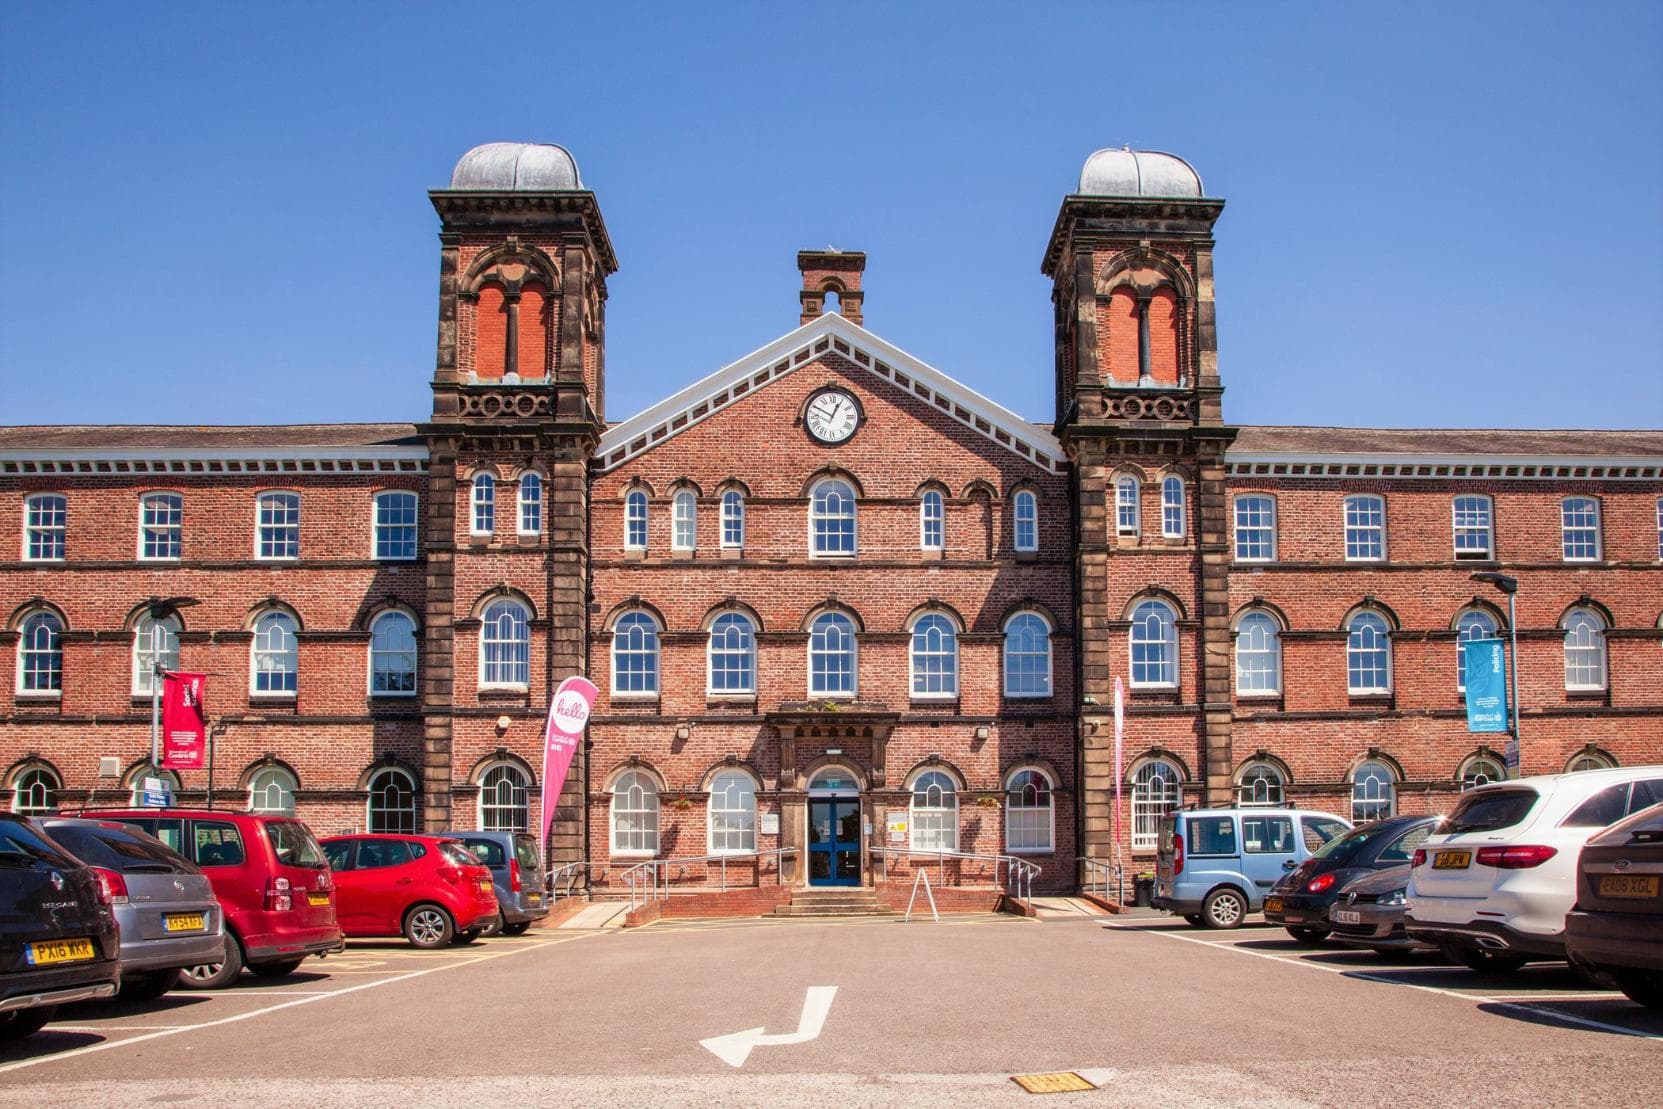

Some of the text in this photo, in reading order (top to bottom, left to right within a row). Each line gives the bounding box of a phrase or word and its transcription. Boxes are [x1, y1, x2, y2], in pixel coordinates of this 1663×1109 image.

[1491, 644, 1501, 673] Policing
[182, 684, 191, 707] Social
[557, 697, 586, 720] hello
[1631, 879, 1653, 894] XGL
[37, 940, 89, 960] PX16 WKR
